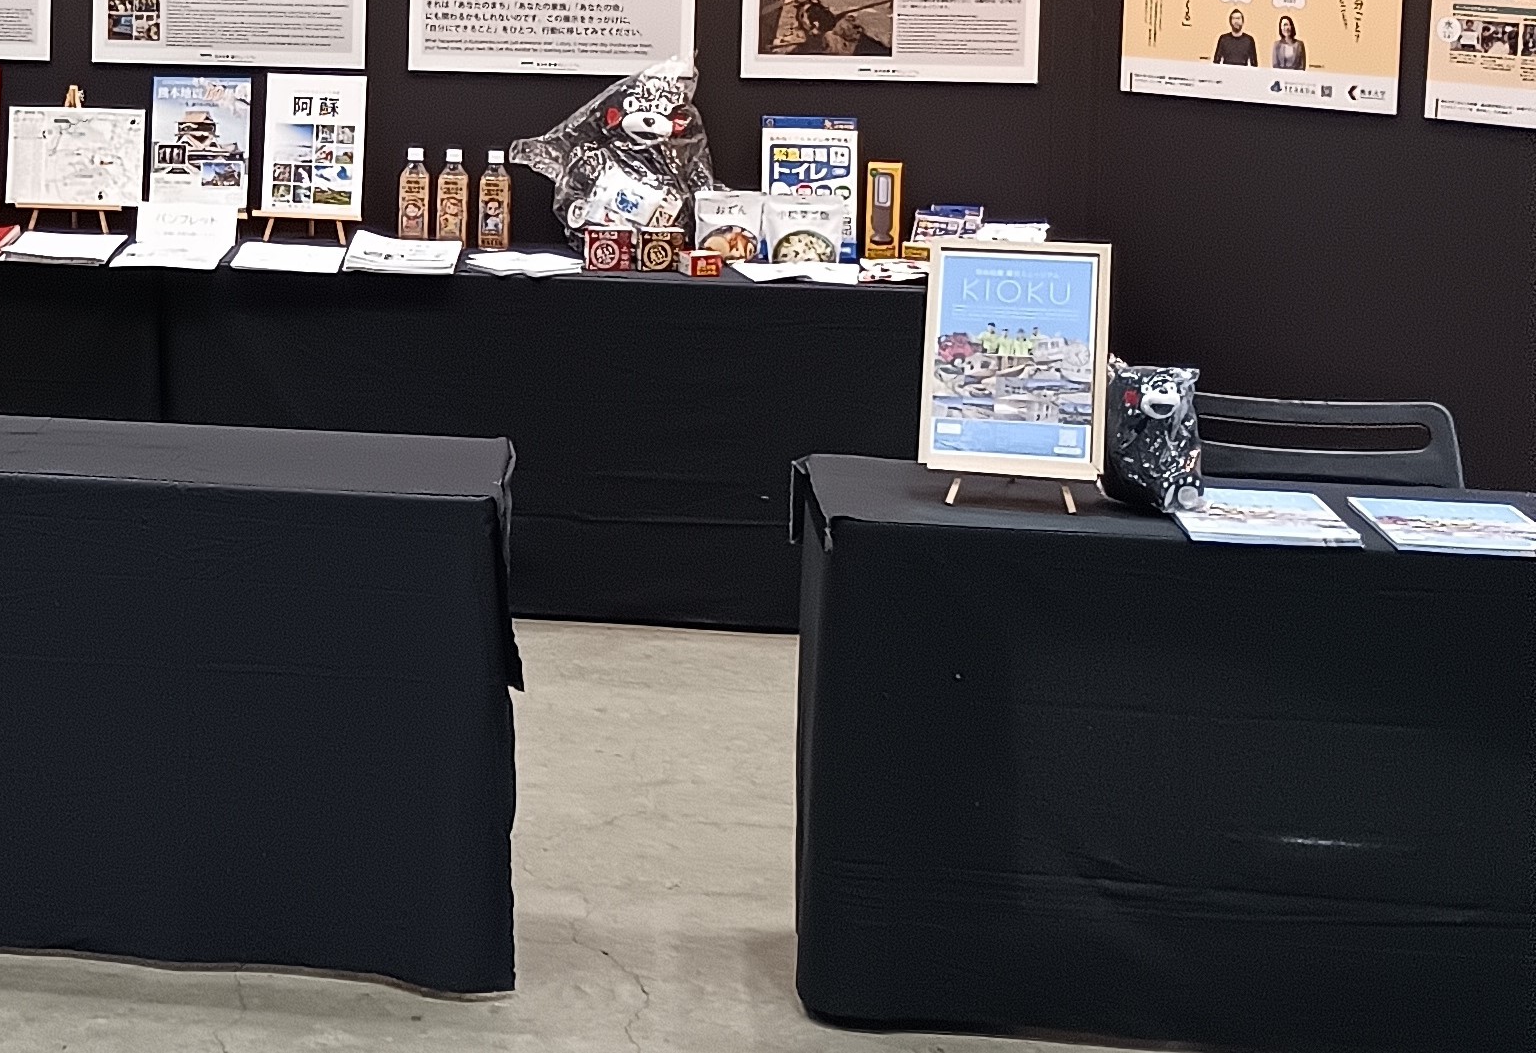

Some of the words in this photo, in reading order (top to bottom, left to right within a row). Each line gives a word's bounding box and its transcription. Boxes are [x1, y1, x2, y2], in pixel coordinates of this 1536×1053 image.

[293, 96, 340, 117] 阿蘇
[773, 162, 828, 180] トイレ
[715, 205, 747, 216] おでん
[963, 277, 1071, 305] KIOKU
